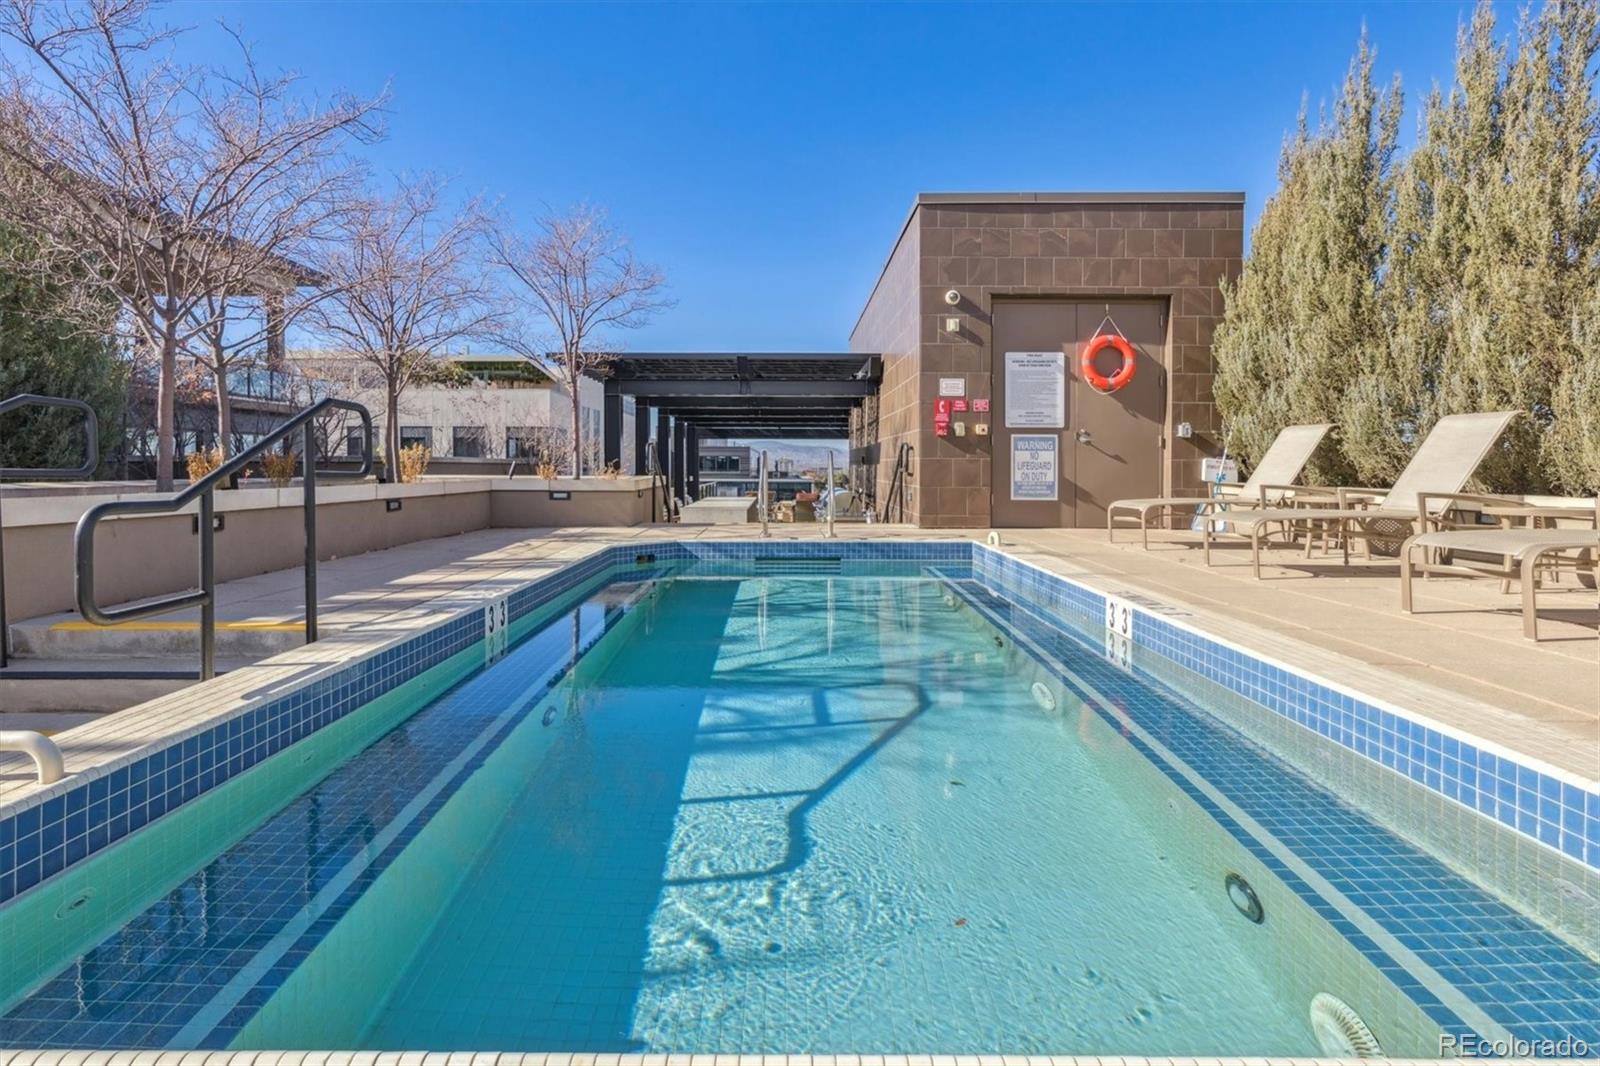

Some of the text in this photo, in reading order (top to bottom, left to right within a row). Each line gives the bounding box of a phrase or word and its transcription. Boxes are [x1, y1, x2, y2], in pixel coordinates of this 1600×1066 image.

[1017, 441, 1053, 450] WARNING
[1030, 452, 1039, 461] NO
[1017, 461, 1052, 471] LIFEGUARD
[1021, 472, 1048, 481] ON DUTY
